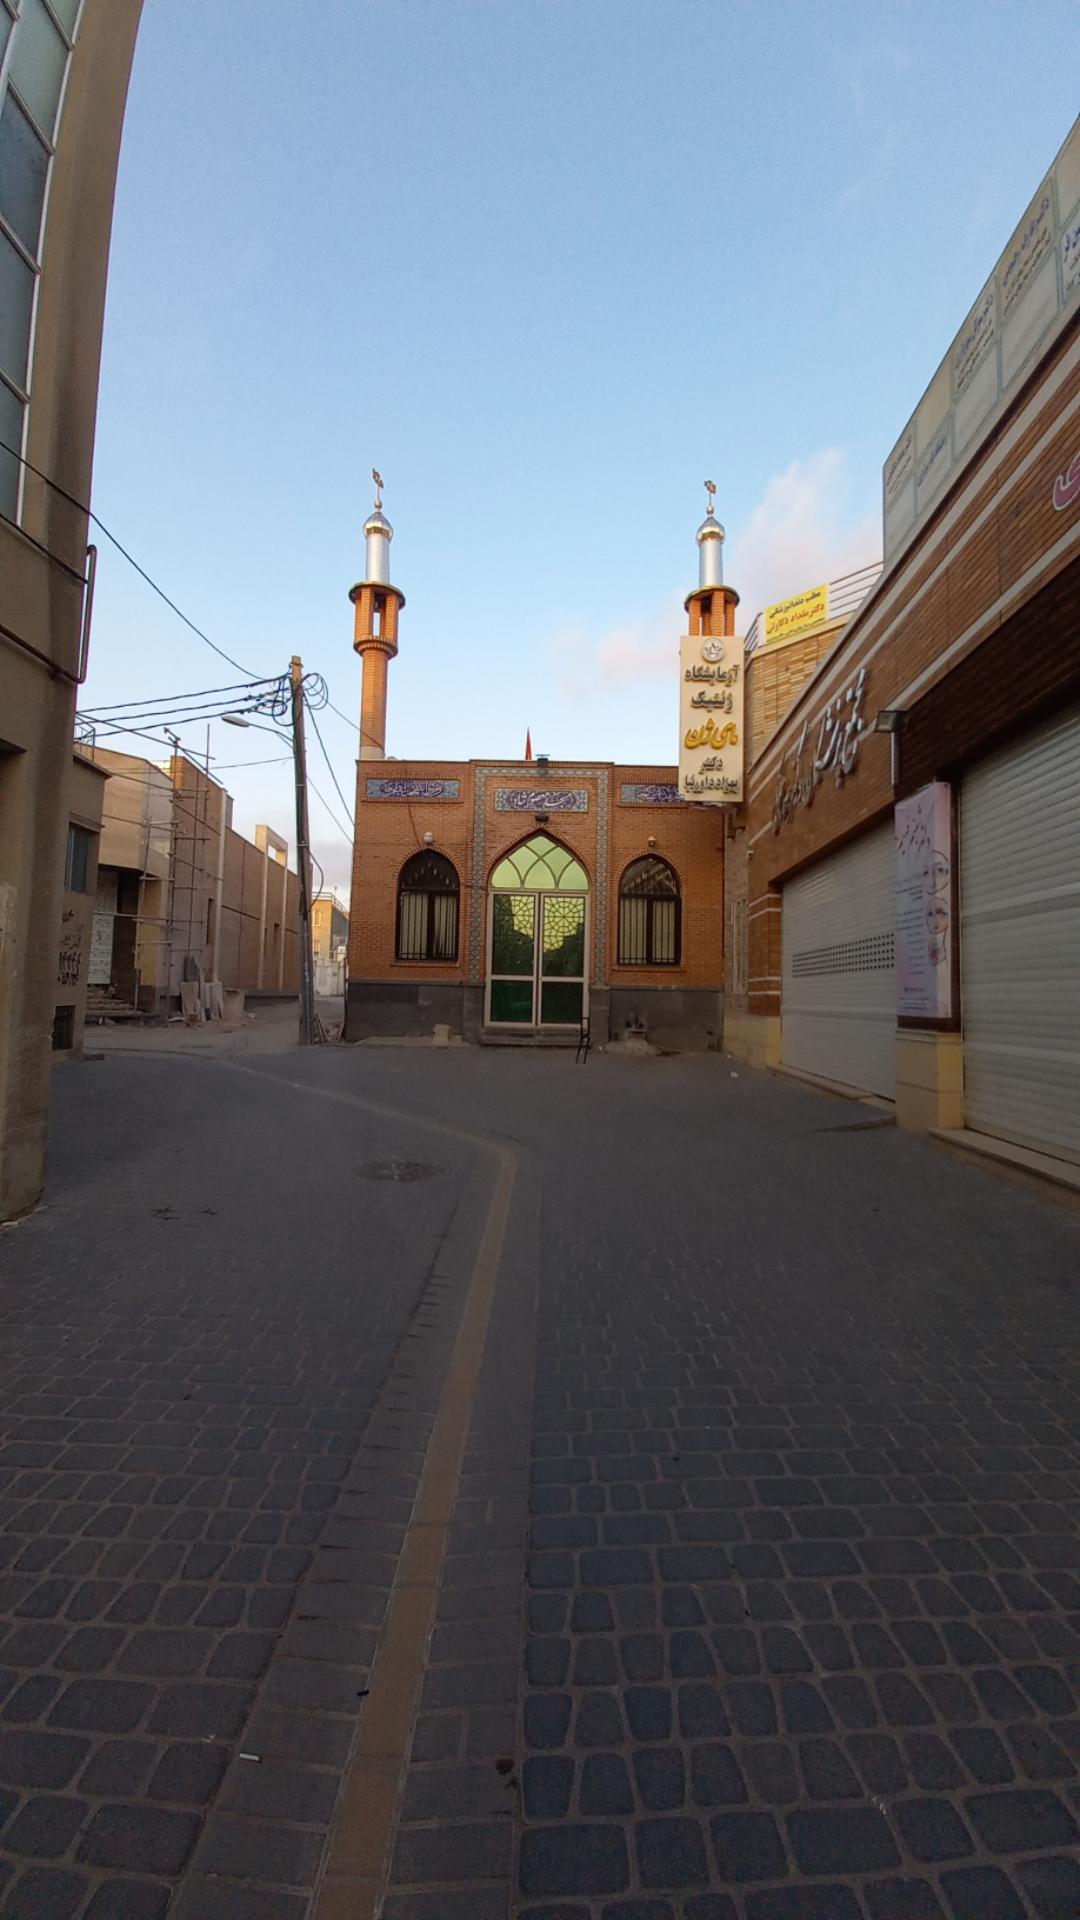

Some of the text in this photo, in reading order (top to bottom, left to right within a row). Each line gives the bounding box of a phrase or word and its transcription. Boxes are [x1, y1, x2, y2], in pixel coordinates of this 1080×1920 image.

[685, 665, 739, 686] آزمایشگاه
[691, 691, 732, 713] ژنتیک
[699, 756, 723, 773] دکتر
